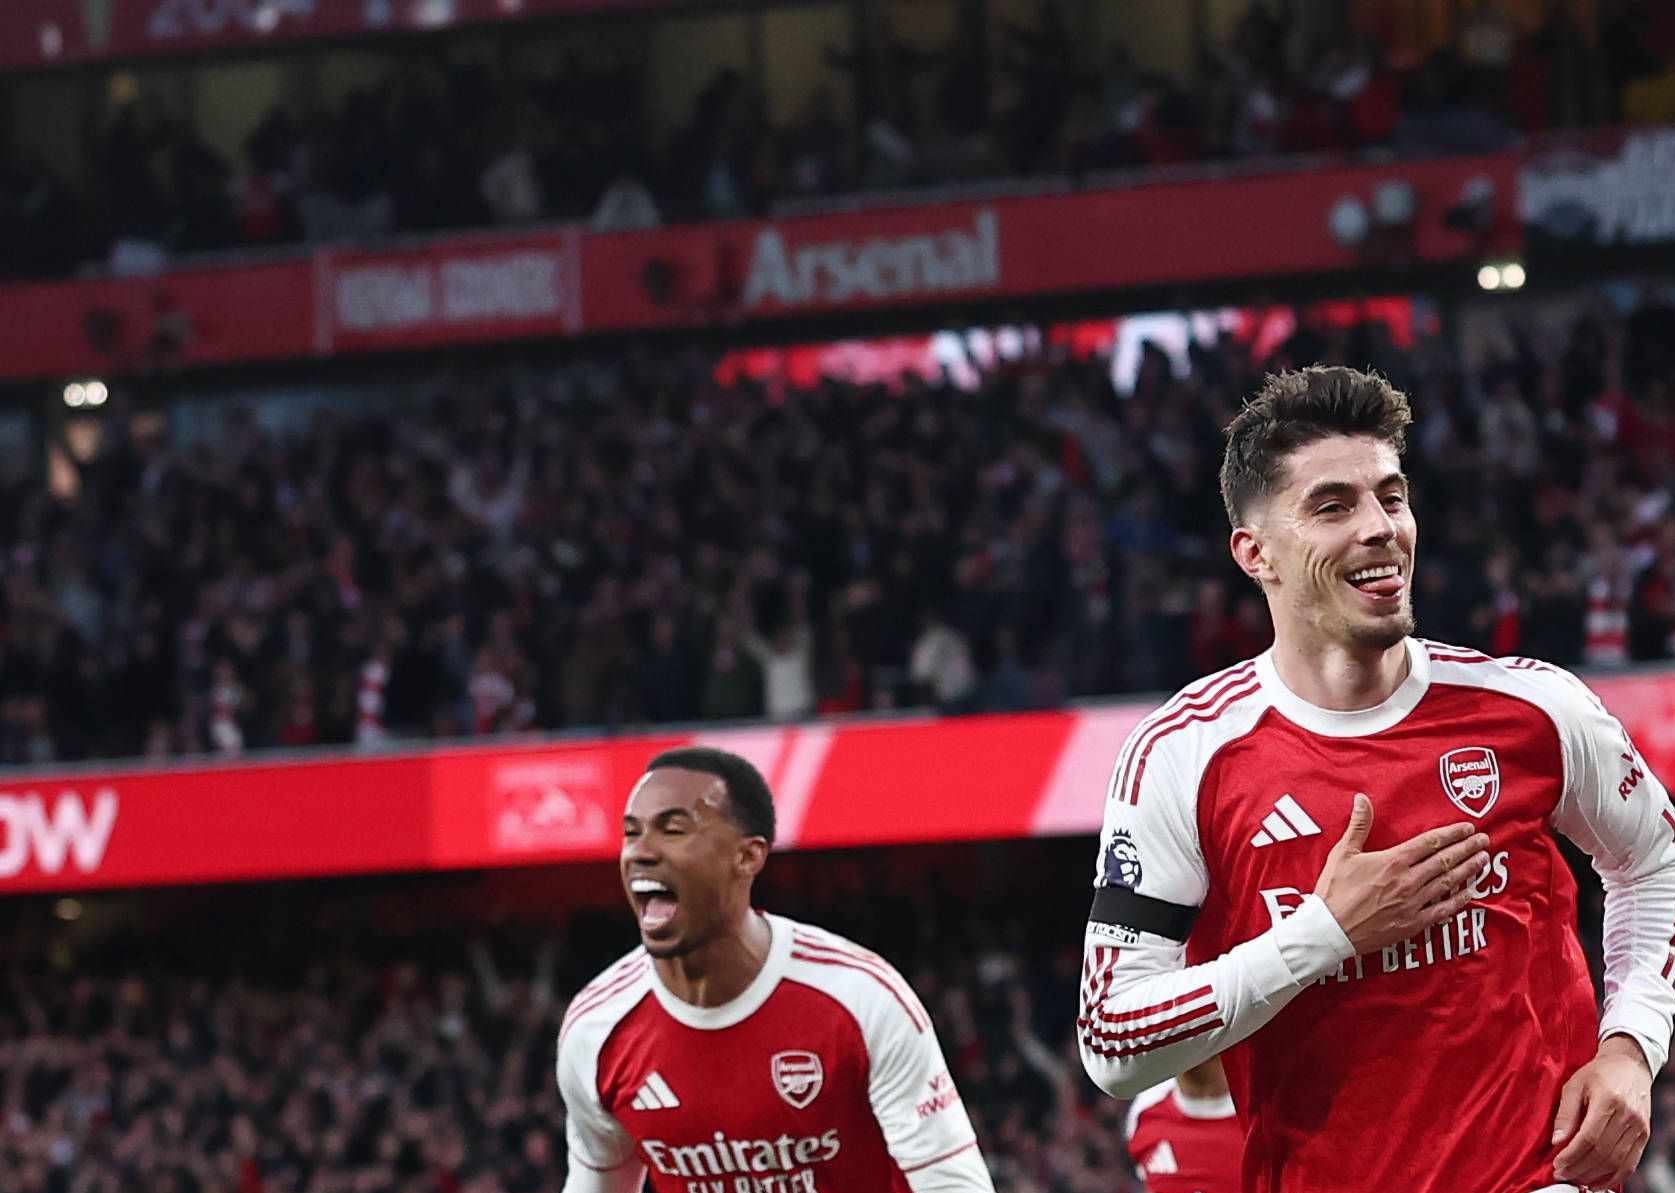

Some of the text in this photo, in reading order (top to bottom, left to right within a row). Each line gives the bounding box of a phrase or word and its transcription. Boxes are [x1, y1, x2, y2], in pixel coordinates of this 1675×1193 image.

[744, 207, 998, 303] Arsenal
[1449, 757, 1490, 774] Arsenal
[1381, 907, 1488, 973] BETTER
[641, 1128, 841, 1177] Emirates
